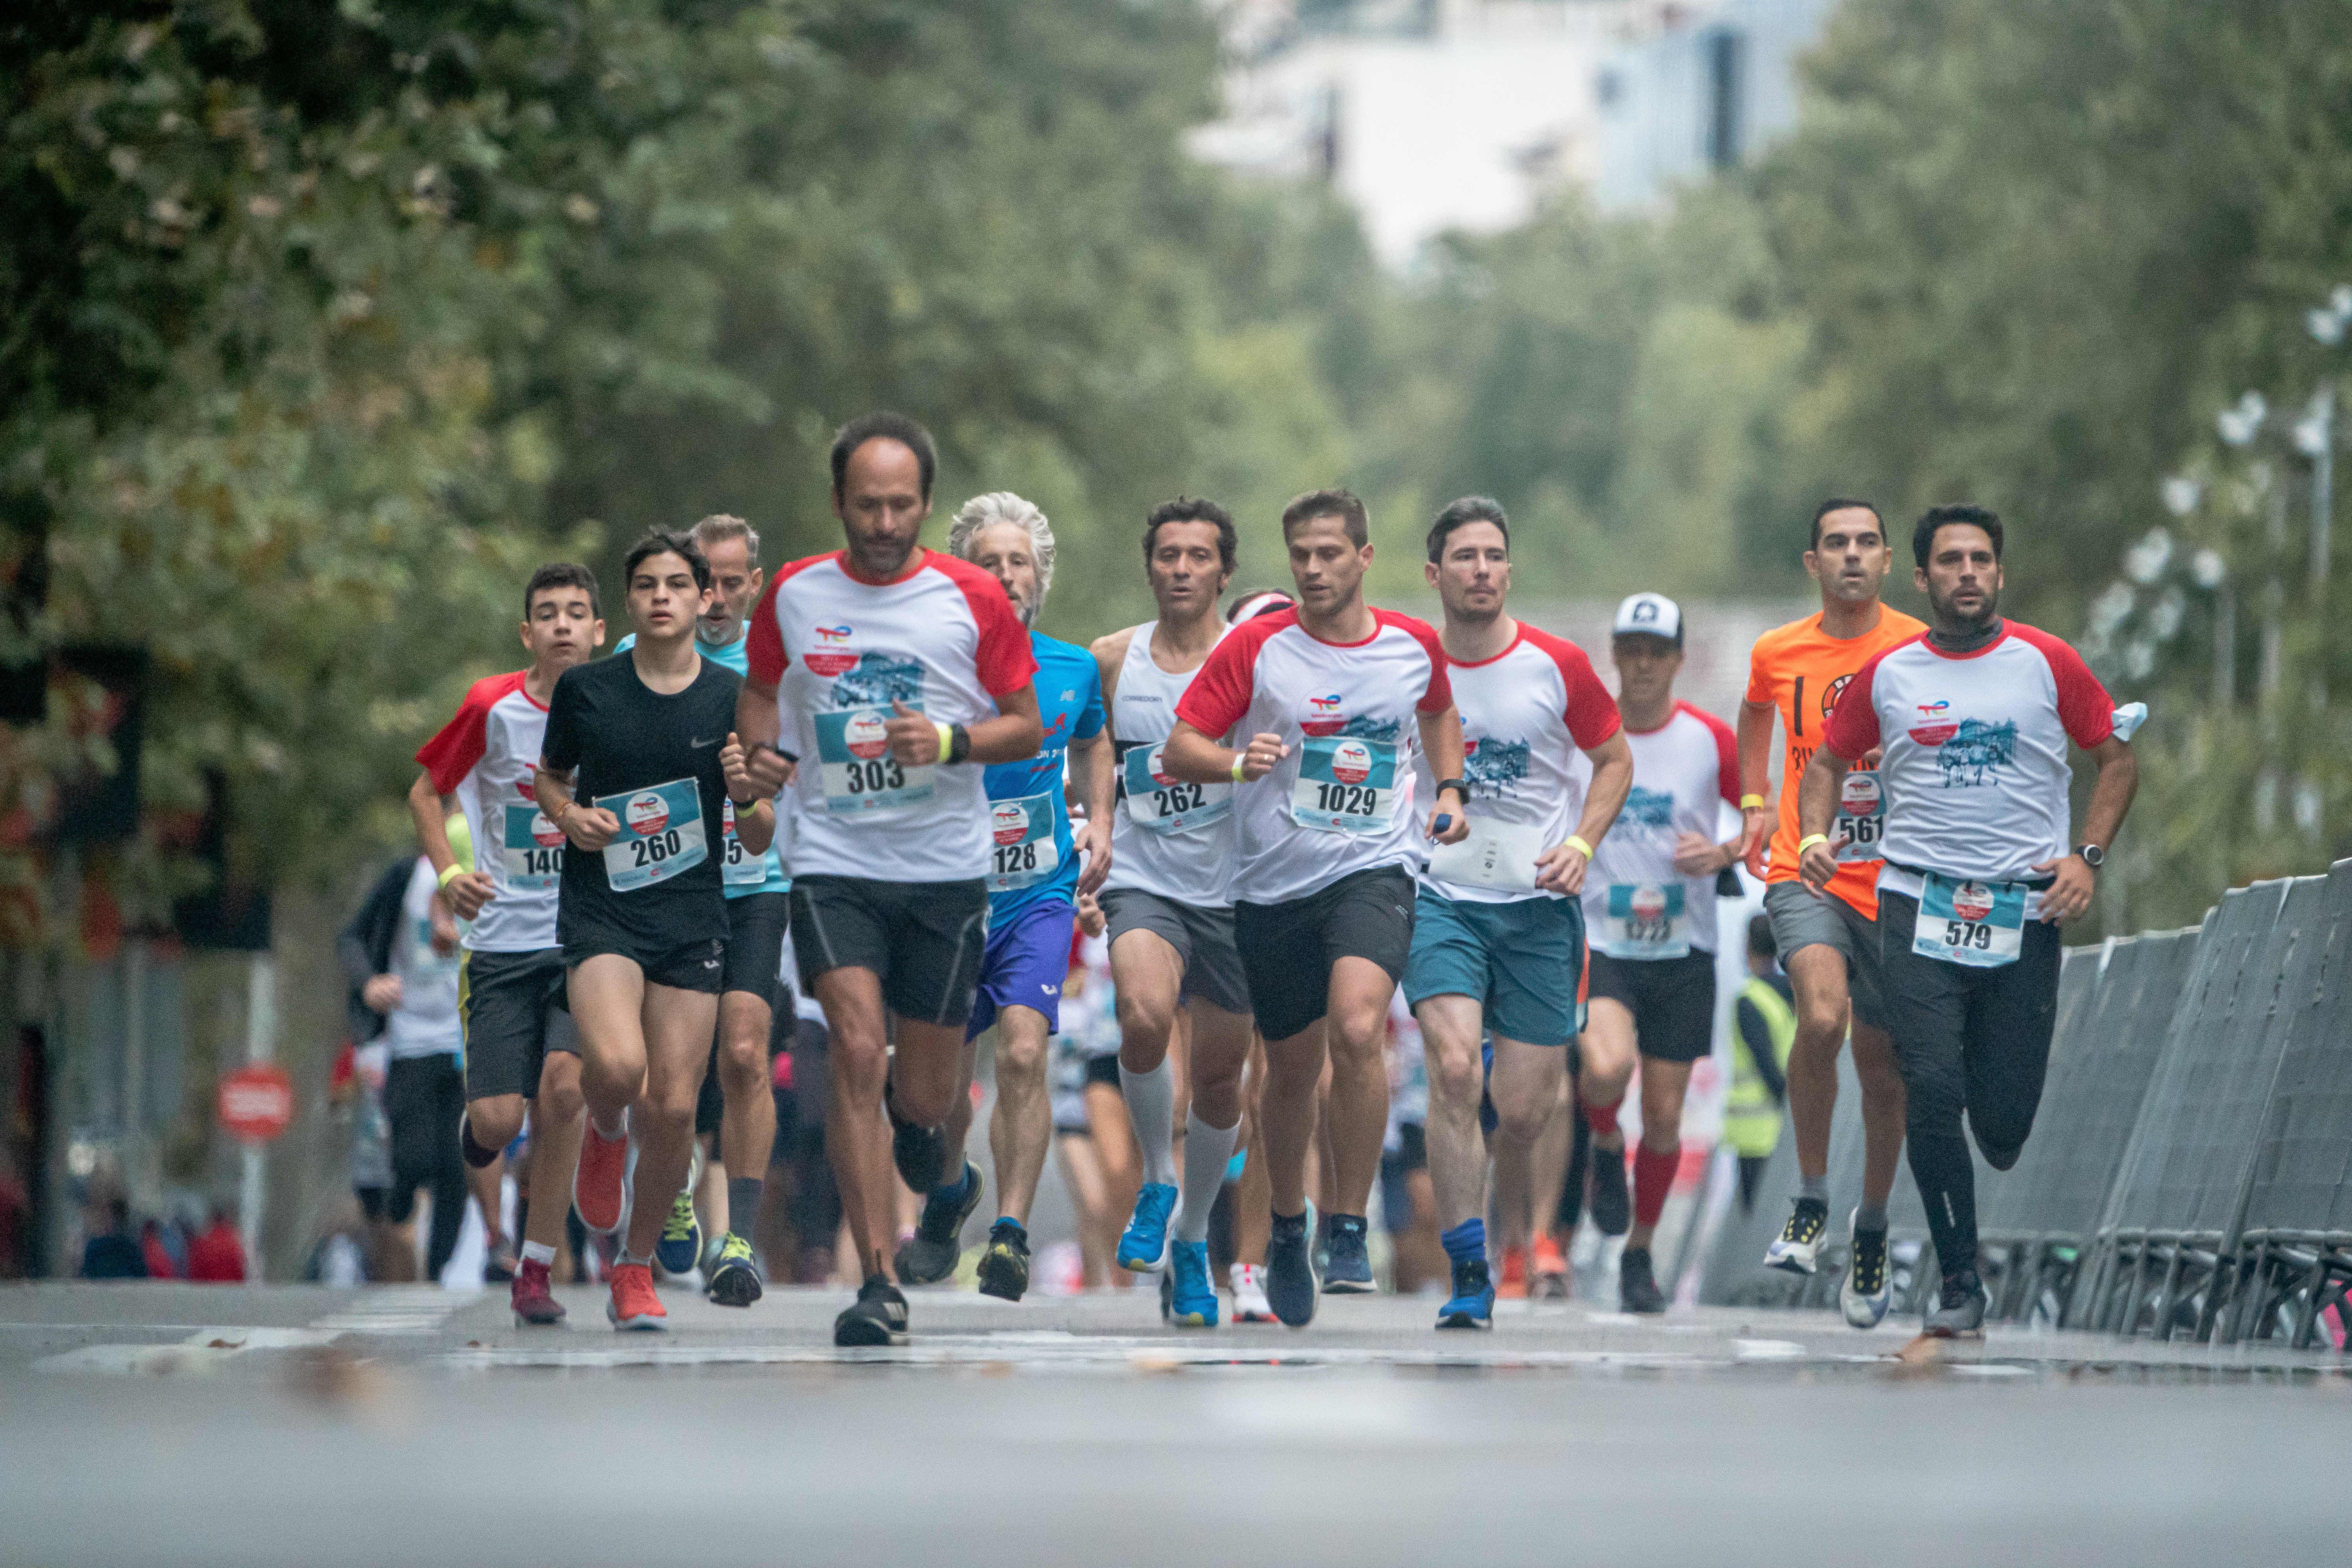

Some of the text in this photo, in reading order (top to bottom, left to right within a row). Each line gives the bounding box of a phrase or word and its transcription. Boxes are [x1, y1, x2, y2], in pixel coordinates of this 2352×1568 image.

[847, 758, 905, 795] 303
[1154, 783, 1206, 817] 262
[1318, 783, 1377, 816] 1029
[1840, 816, 1884, 844] 561
[523, 848, 564, 875] 140
[630, 829, 681, 868] 260
[995, 842, 1037, 873] 128
[1945, 920, 1991, 950] 579
